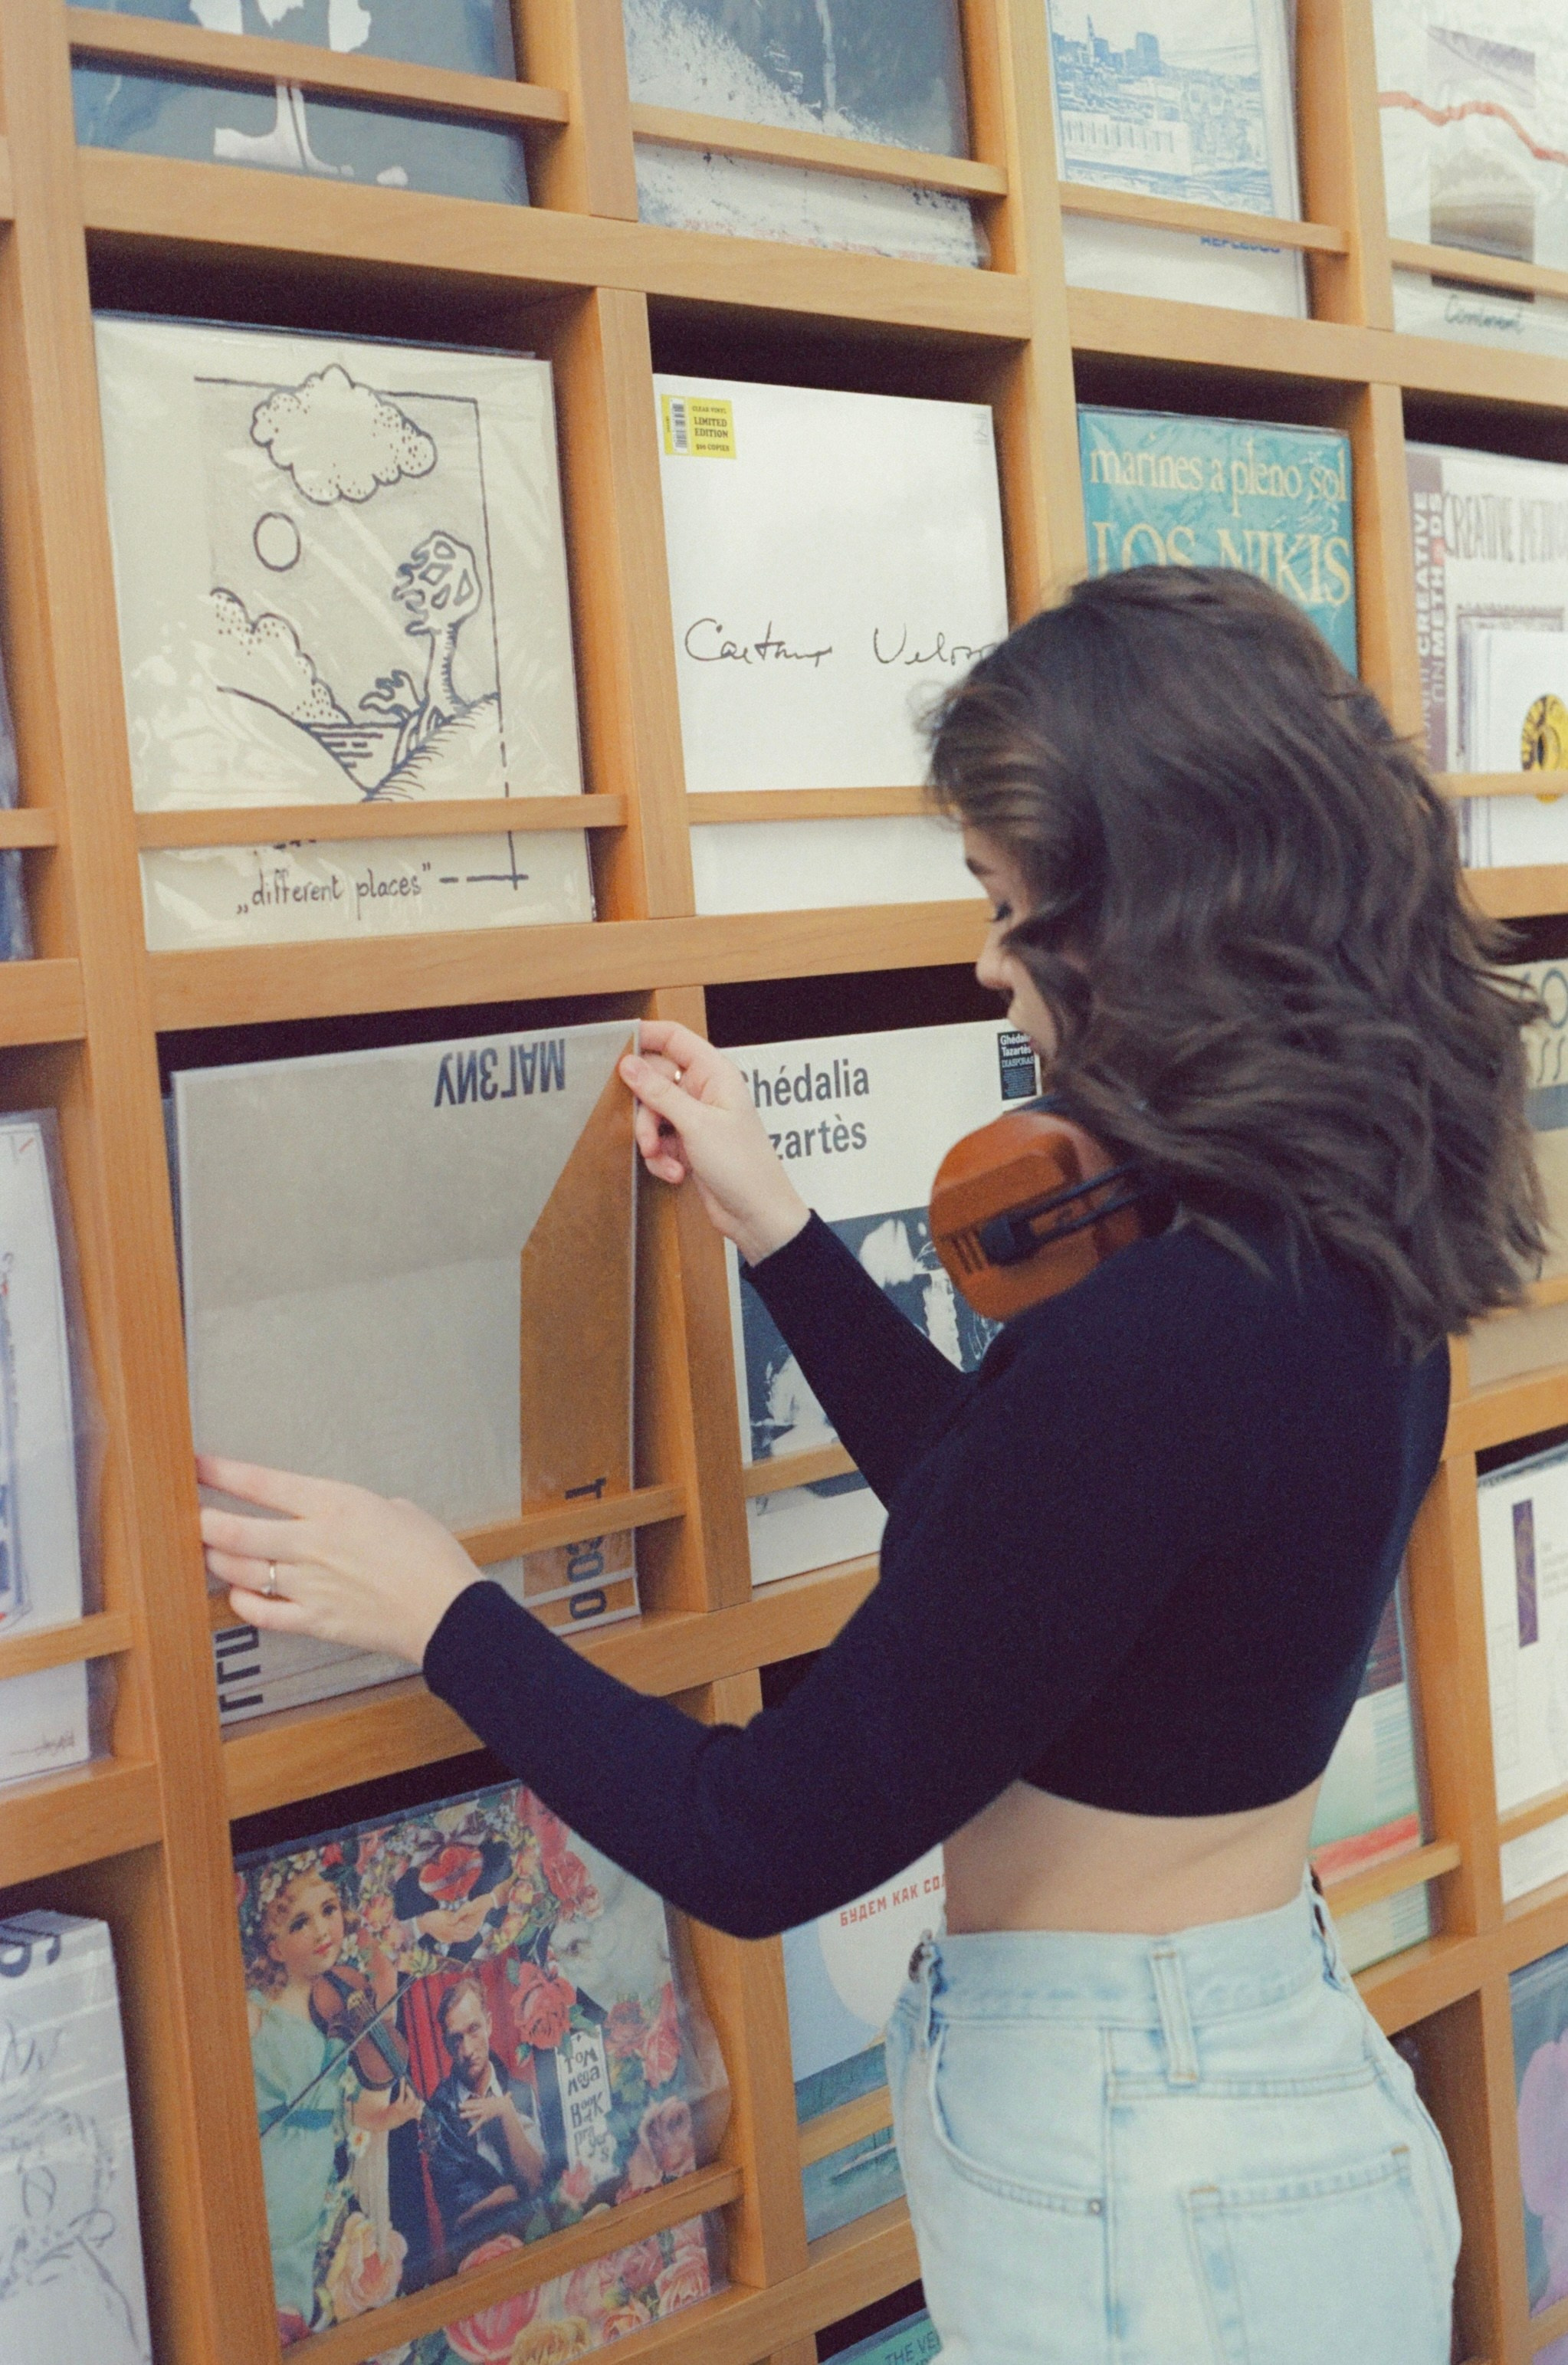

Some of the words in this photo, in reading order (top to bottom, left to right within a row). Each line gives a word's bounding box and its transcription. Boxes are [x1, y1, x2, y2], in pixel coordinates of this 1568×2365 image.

[694, 416, 727, 427] LIMITED
[694, 428, 729, 438] EDITION
[1091, 448, 1205, 491] marines
[1211, 458, 1225, 492] a
[1231, 438, 1302, 519] pleno
[1310, 447, 1347, 503] sol
[1217, 528, 1351, 605] NIKIS
[1413, 491, 1431, 657] CREATIVE
[1000, 1034, 1031, 1045] Ghédali
[740, 1058, 870, 1108] hédalia
[768, 1114, 868, 1160] zartès
[840, 1896, 887, 1927] БУДЕМ
[892, 1884, 919, 1907] КАК
[923, 1874, 946, 1894] СО
[884, 2342, 914, 2365] THE
[916, 2330, 938, 2354] VE
